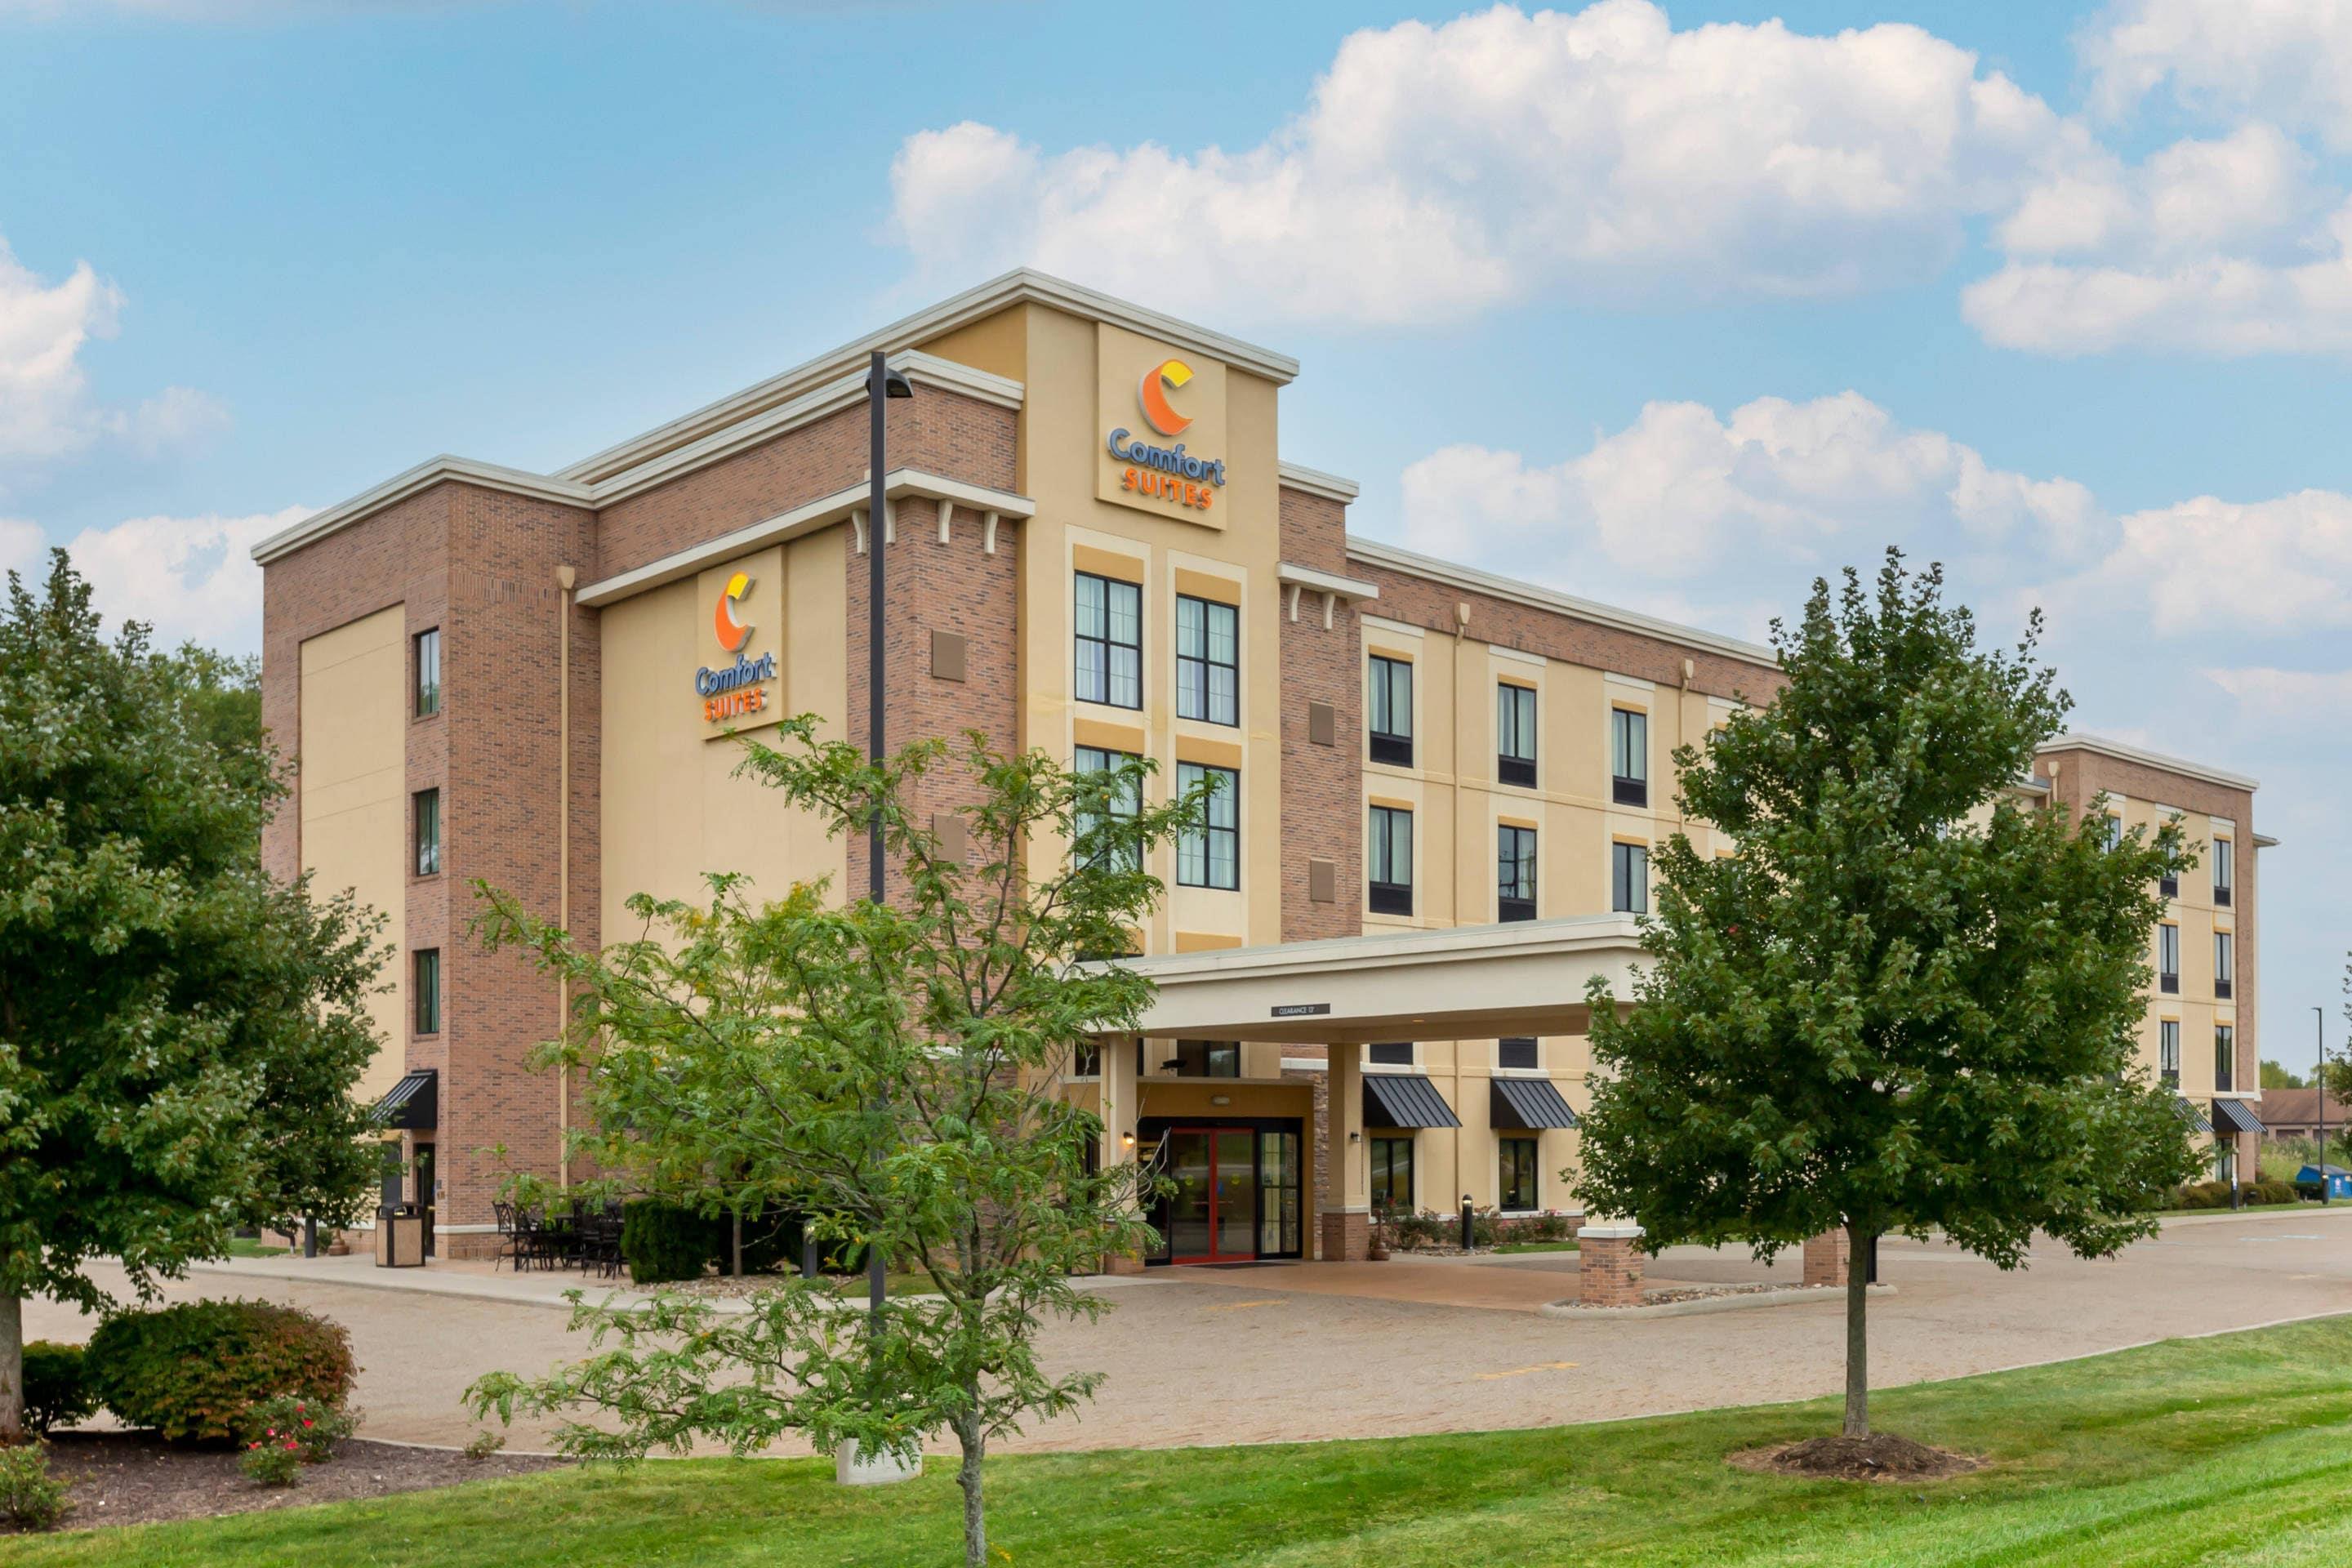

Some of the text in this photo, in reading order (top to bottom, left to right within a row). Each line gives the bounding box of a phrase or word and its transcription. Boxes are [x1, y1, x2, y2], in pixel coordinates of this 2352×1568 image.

[1107, 427, 1226, 487] Comfort
[1122, 466, 1213, 509] SUITES
[696, 653, 777, 697] Comfort
[705, 687, 768, 722] SUITES
[1280, 1006, 1307, 1014] CLEARANCE
